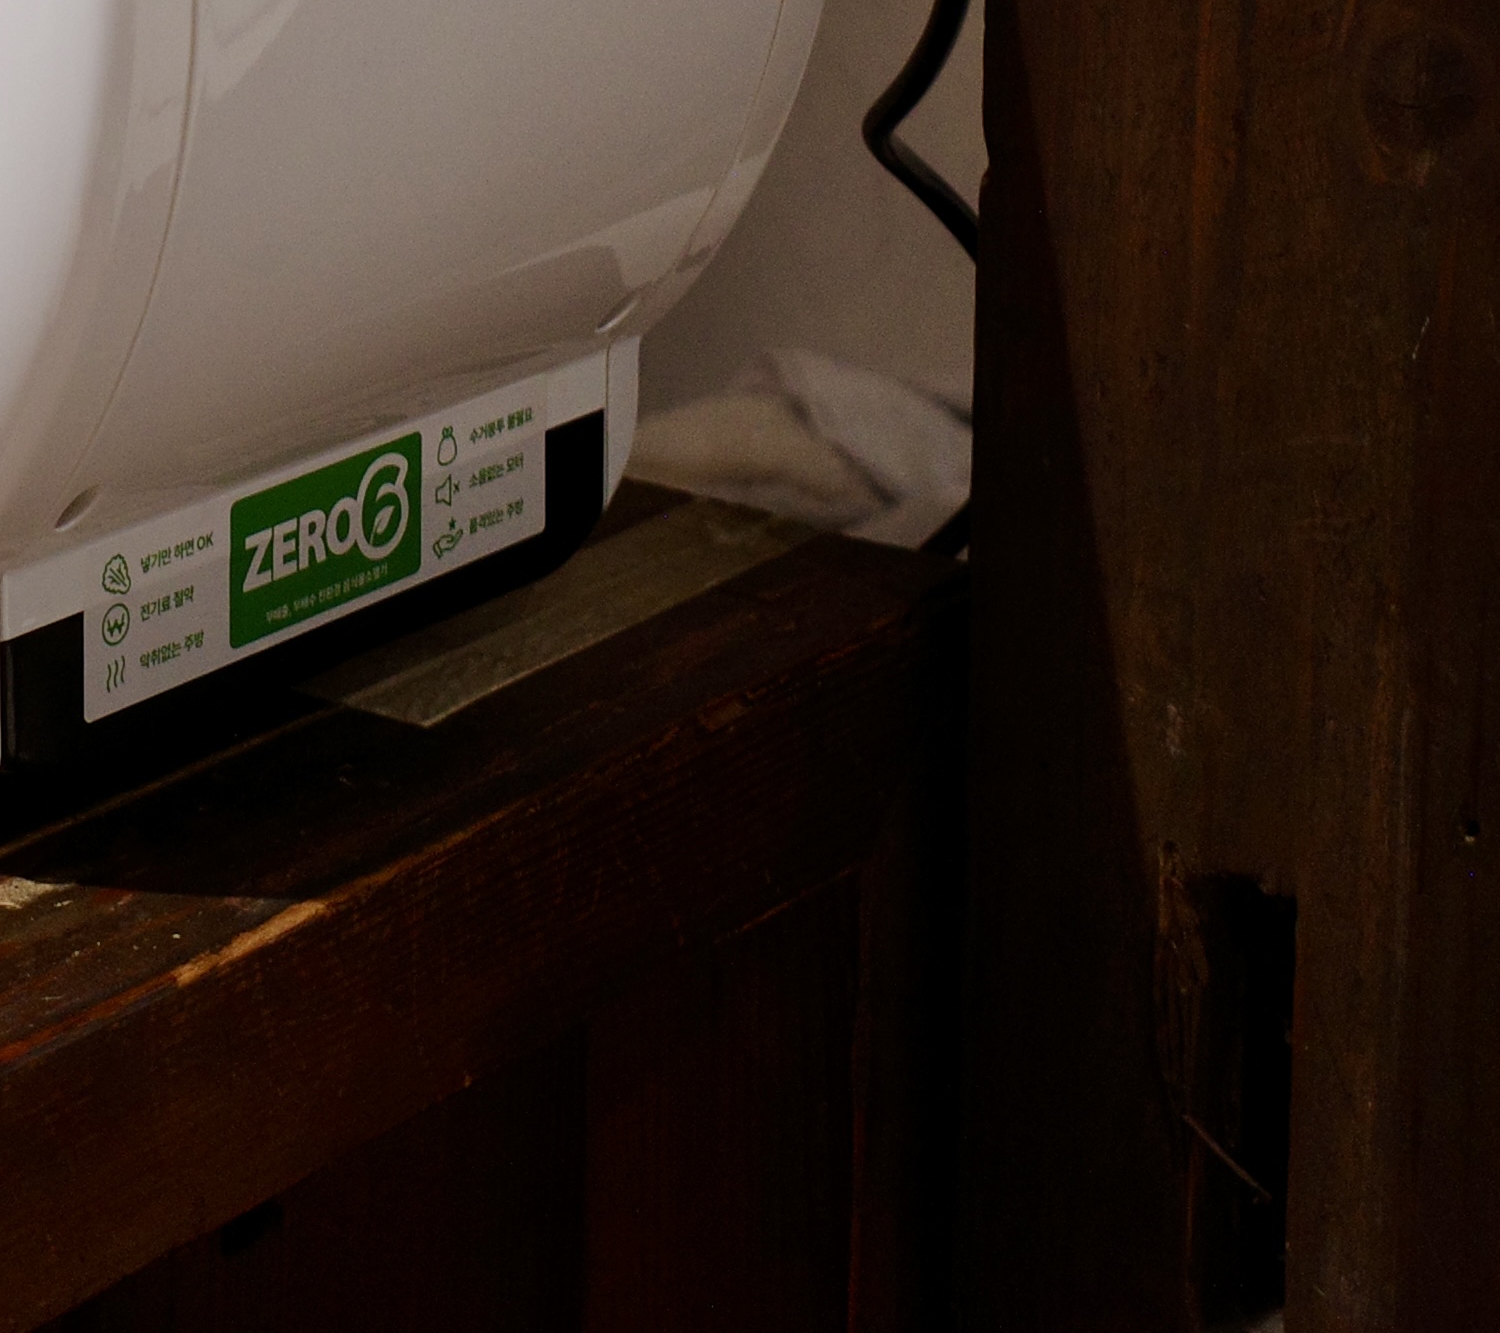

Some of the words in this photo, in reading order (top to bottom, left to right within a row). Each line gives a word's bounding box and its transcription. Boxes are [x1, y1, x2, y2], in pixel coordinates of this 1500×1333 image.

[469, 463, 505, 489] 소음없는
[506, 452, 524, 472] 모터
[506, 496, 524, 519] 주방
[140, 546, 172, 574] 넣기만
[174, 537, 195, 560] 하면
[196, 531, 214, 551] OK
[140, 595, 171, 622] 전기료
[173, 584, 195, 609] 절약
[139, 640, 182, 669] 악취없는
[184, 629, 205, 652] 주방
